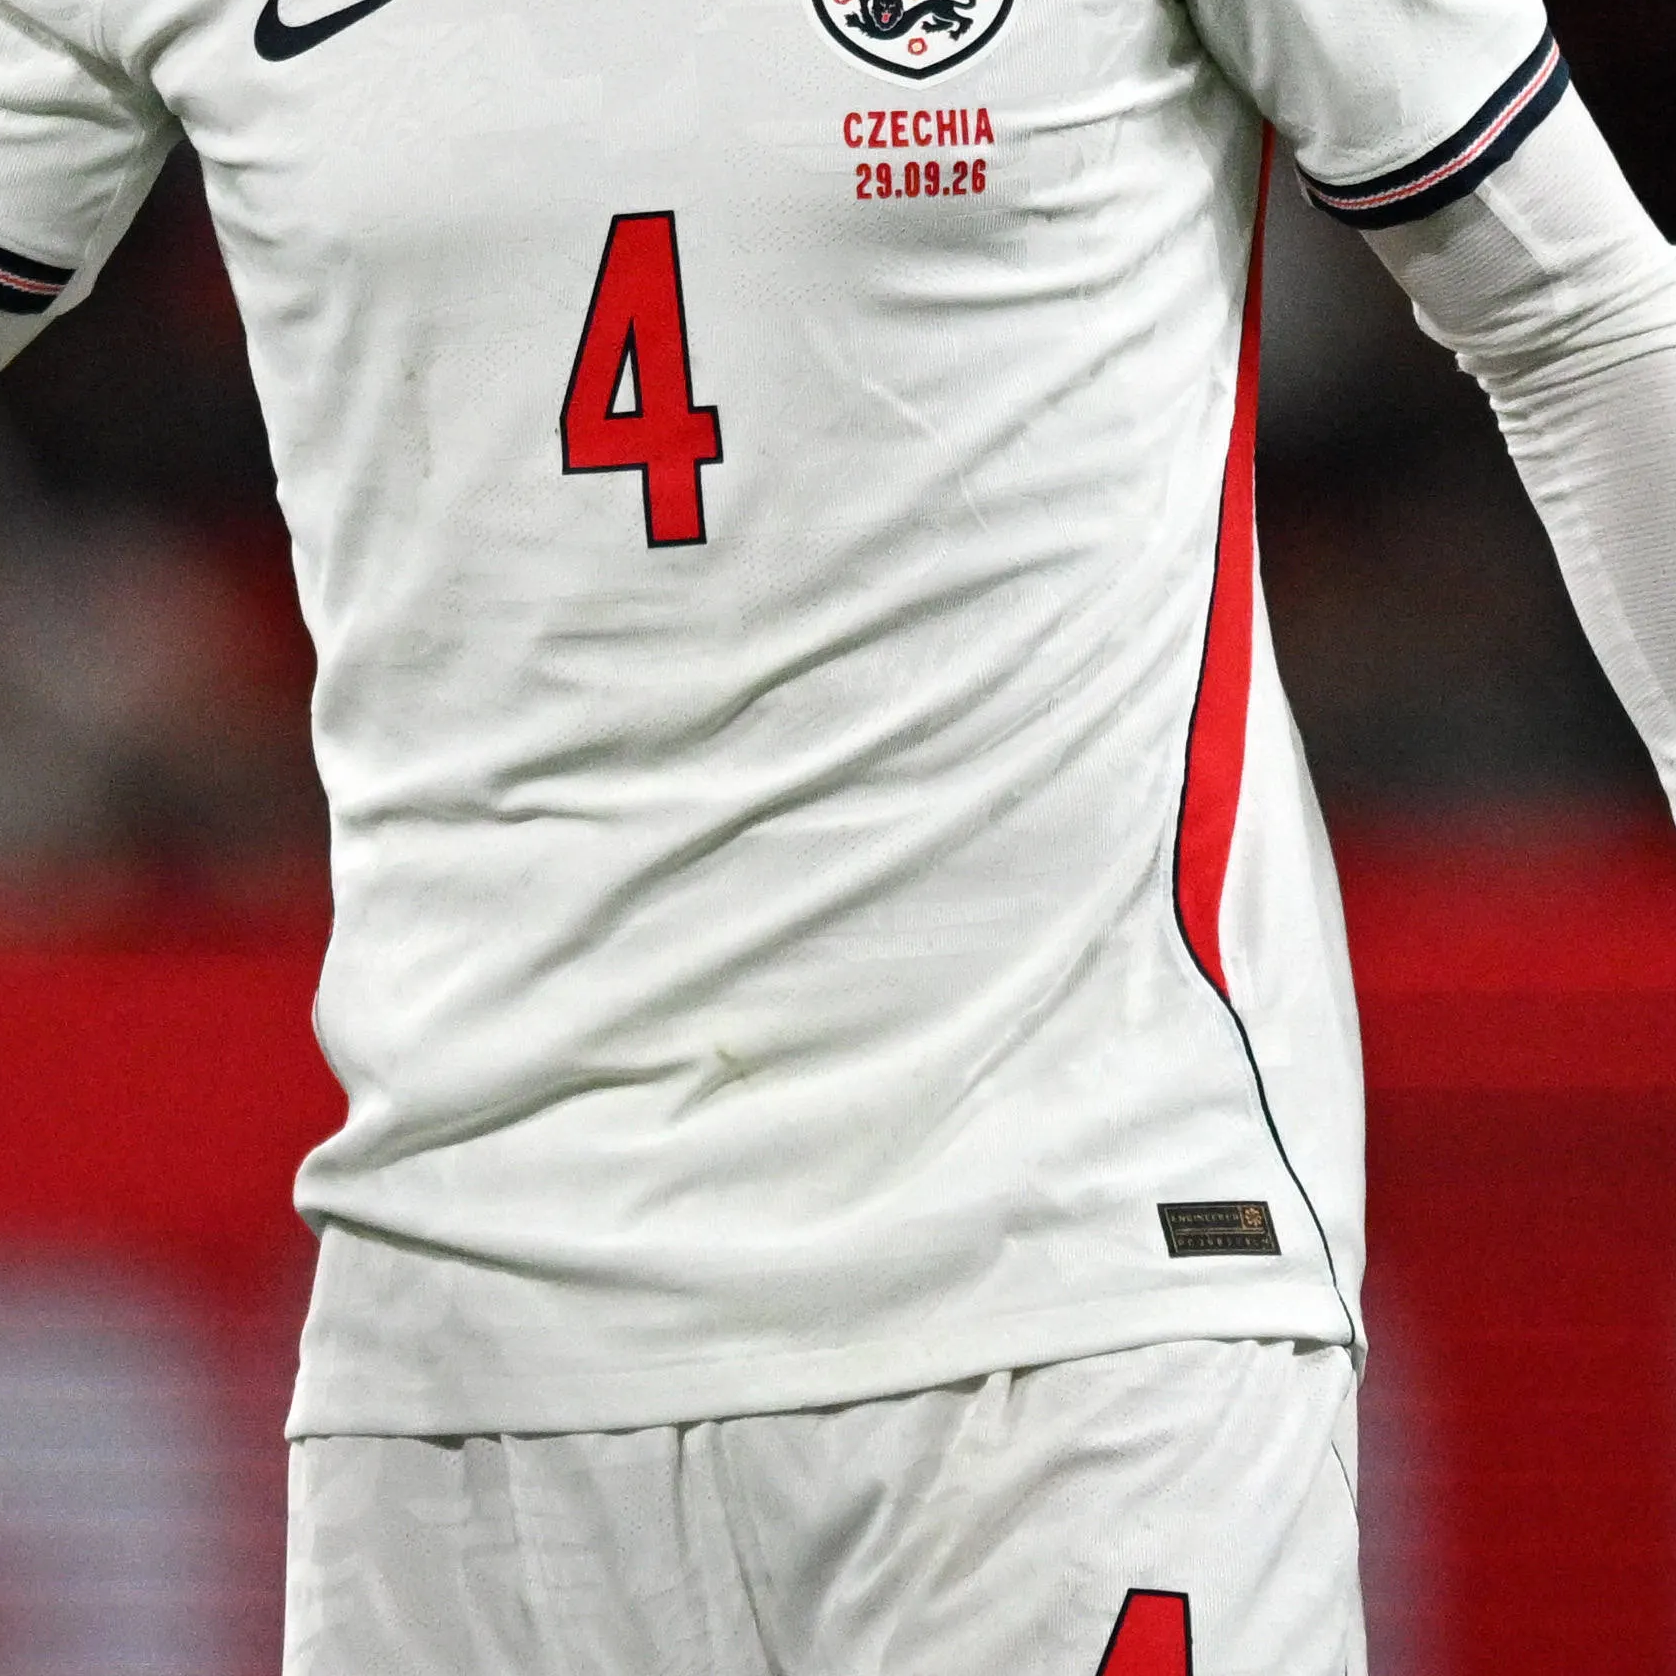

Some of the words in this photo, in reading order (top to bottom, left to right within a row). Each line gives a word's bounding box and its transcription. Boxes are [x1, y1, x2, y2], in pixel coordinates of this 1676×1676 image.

[843, 107, 995, 149] CZECHIA
[855, 158, 987, 200] 29.09.26
[559, 210, 724, 549] 4
